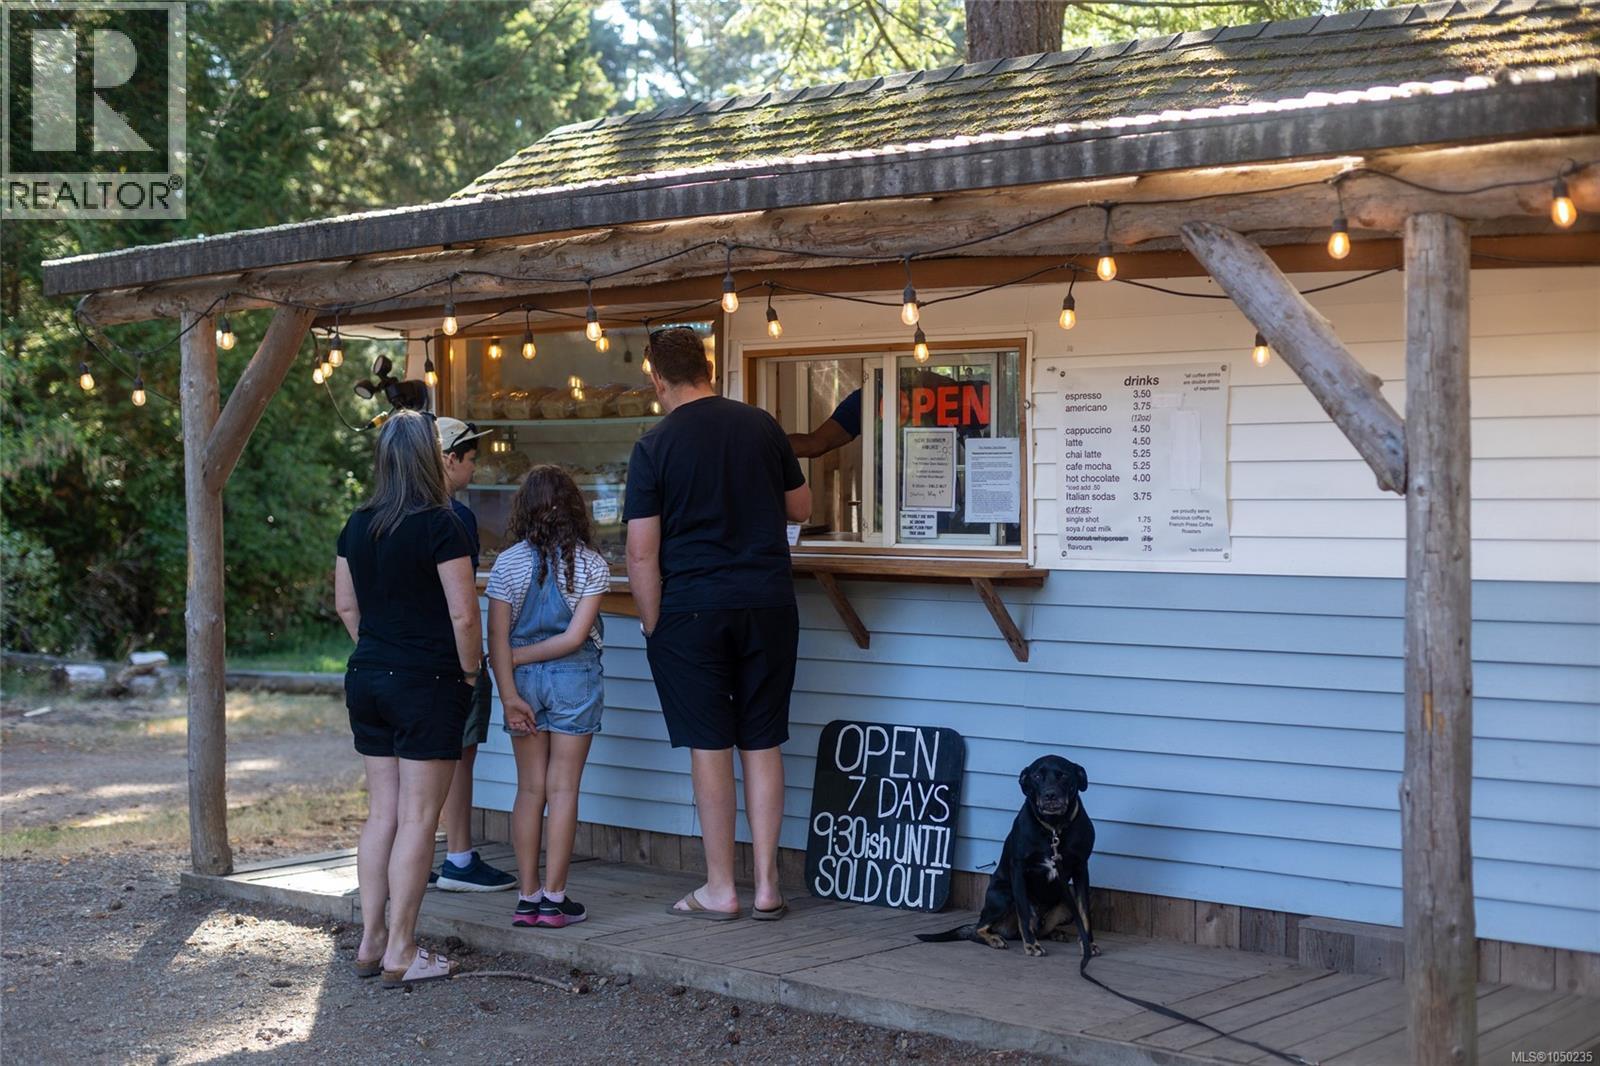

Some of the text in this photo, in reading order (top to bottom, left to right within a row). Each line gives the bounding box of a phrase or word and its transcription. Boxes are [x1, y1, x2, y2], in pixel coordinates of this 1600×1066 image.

[1124, 375, 1160, 387] drinks
[1065, 389, 1152, 401] espresso 3.50
[1065, 401, 1152, 412] americano 3.75
[1131, 413, 1152, 422] (12oz)
[1065, 424, 1151, 436] cappuccino 4.50
[1065, 436, 1151, 447] latte 4.50
[1065, 448, 1151, 459] chai latte 5.25
[1065, 461, 1151, 471] cafe mocha 5.25
[1065, 473, 1151, 483] hot chocolate 4.00
[1066, 491, 1152, 501] Italian sodas 3.75
[1065, 505, 1093, 515] extras:
[1066, 516, 1084, 524] single
[1065, 525, 1081, 533] soya
[1141, 525, 1152, 533] .75
[1067, 543, 1152, 552] flavours .75
[835, 724, 940, 780] OPEN
[849, 776, 950, 823] 7 DAYS
[813, 811, 951, 869] 9:30ish UNTIL
[815, 855, 944, 909] SOLD OUT
